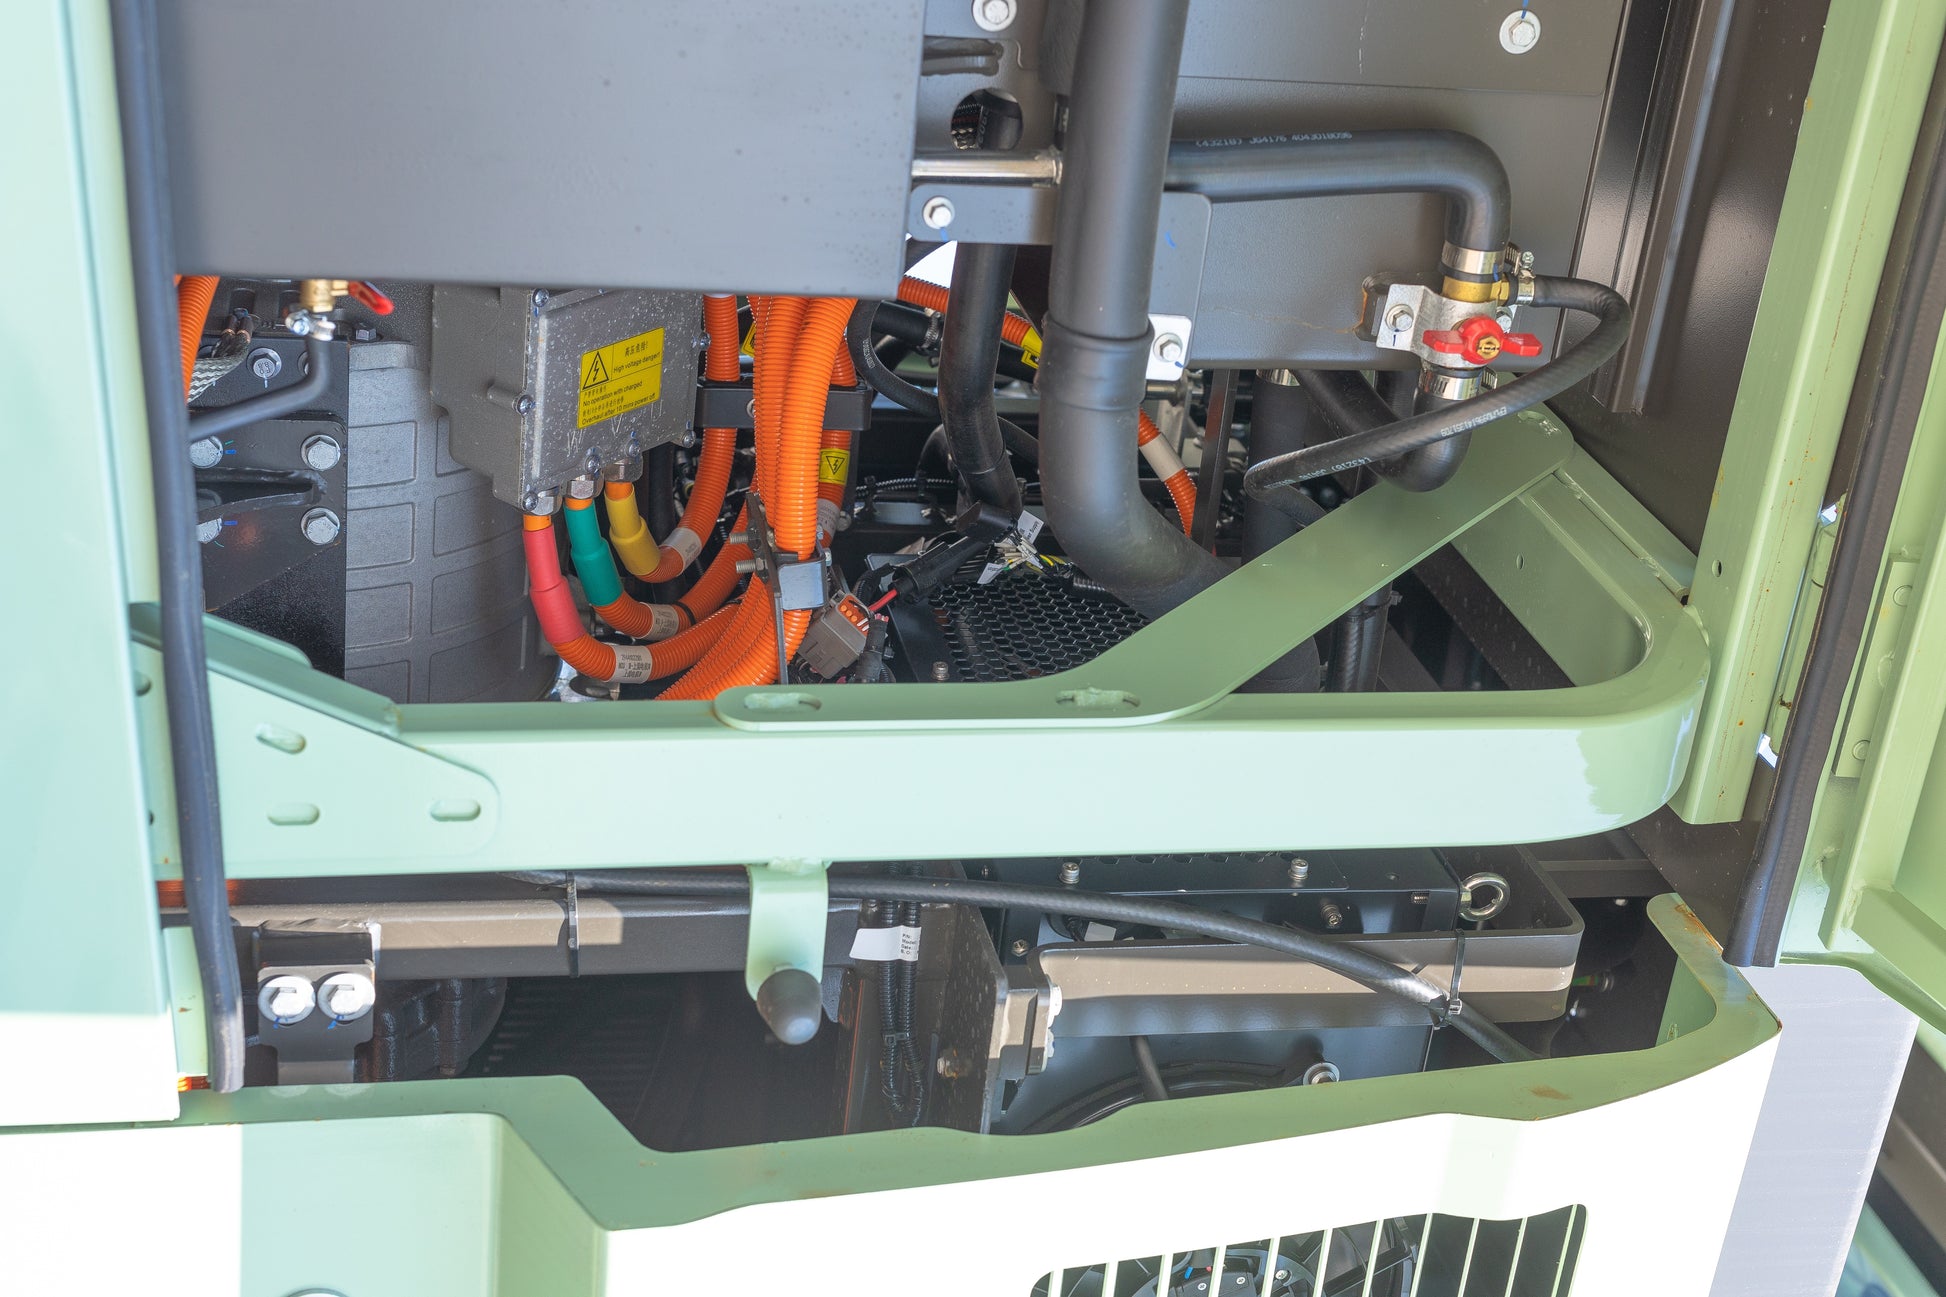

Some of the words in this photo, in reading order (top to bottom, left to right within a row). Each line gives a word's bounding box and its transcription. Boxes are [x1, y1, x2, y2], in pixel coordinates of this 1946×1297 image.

[613, 364, 624, 374] High
[624, 357, 642, 369] voltage
[591, 392, 613, 405] operation
[613, 388, 624, 396] with
[624, 380, 643, 393] charged
[582, 414, 602, 425] Overhaul
[602, 408, 615, 418] after
